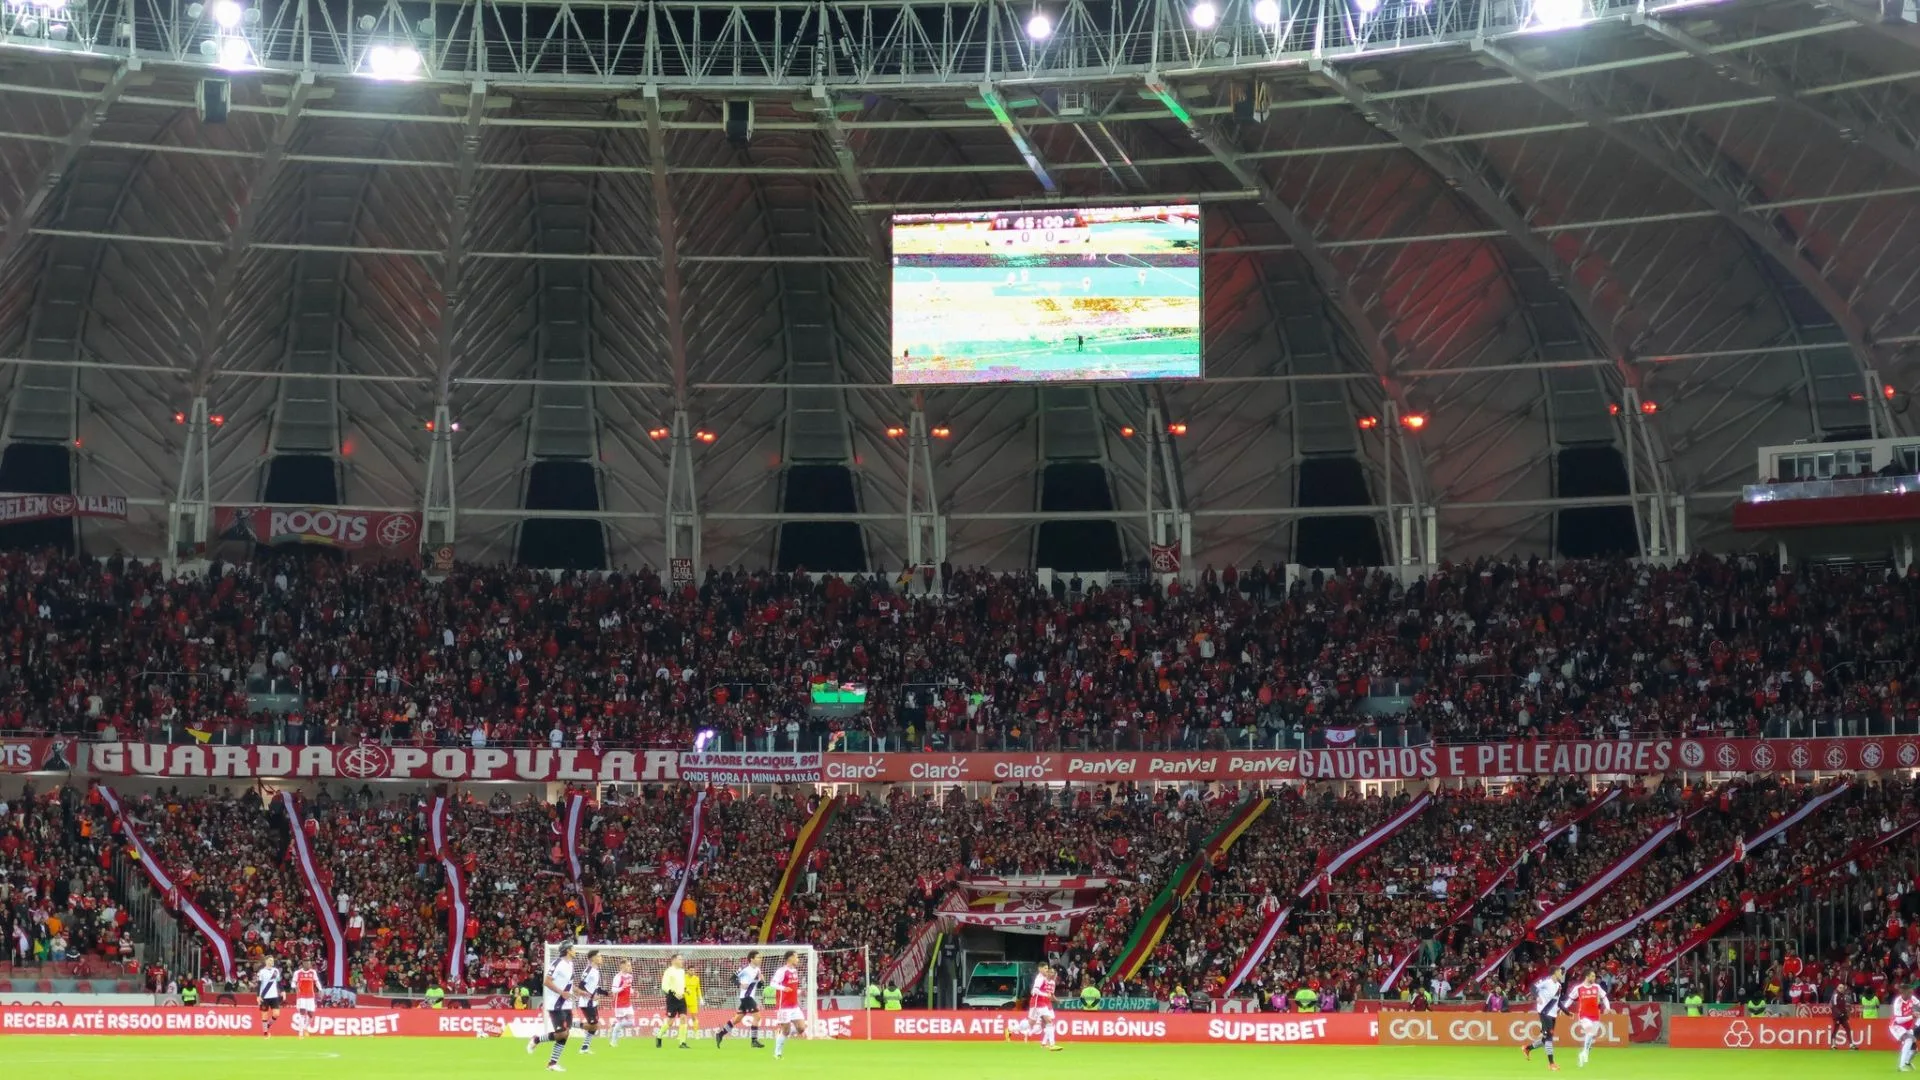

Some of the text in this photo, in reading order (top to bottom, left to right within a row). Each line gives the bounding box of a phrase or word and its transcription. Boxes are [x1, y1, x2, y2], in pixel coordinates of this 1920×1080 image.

[1014, 215, 1063, 230] 45:00
[270, 511, 367, 541] ROOTS
[91, 742, 680, 780] GUARDA POPULAR
[705, 754, 742, 766] PADRE
[827, 760, 878, 778] Claro
[910, 760, 962, 778] Claro
[994, 760, 1046, 778] Claro
[1068, 758, 1137, 774] PanVel
[1149, 757, 1218, 774] PanVel
[1228, 756, 1298, 773] PanVel
[1299, 741, 1672, 778] GAUCHOS E PELEADORES
[682, 771, 821, 783] ONDE MORA A MINHA PAIXÃO
[3, 1010, 253, 1030] RECEBA ATÉ R$500 EM BÔNUS
[894, 1018, 966, 1034] RECEBA
[969, 1014, 1004, 1034] ATÉ
[1071, 1020, 1099, 1036] EM
[1102, 1016, 1166, 1037] BÔNUS
[1389, 1018, 1439, 1040] GOL
[1208, 1018, 1328, 1042] SUPERBET
[1449, 1019, 1499, 1041] GOL
[1758, 1023, 1872, 1046] banrisul
